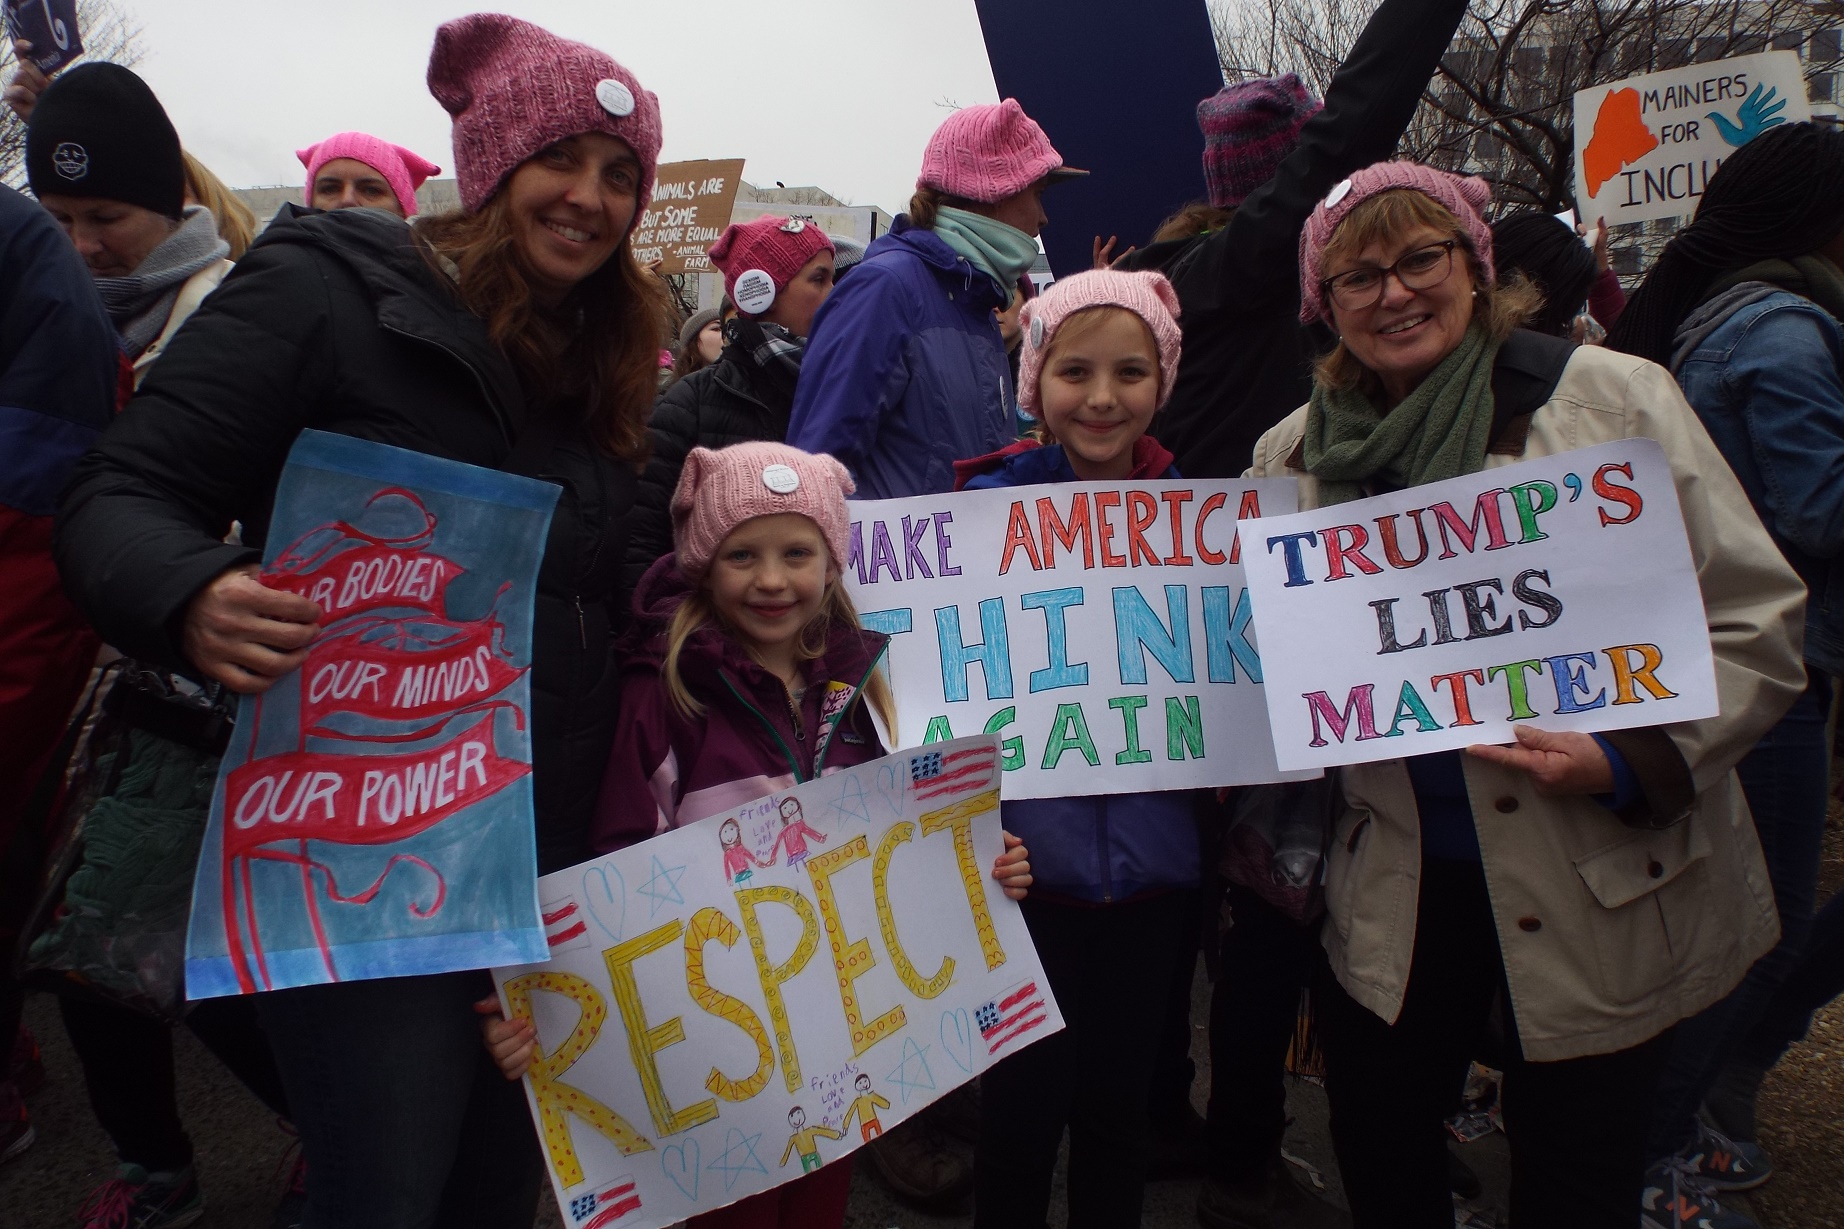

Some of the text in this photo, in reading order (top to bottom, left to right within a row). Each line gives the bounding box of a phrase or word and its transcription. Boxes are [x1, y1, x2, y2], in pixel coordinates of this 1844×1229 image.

[1641, 73, 1748, 115] MAINERS
[1660, 120, 1701, 145] FOR
[640, 205, 698, 229] BUT SOME
[651, 177, 725, 202] ANIMALS ARE
[637, 229, 655, 244] ARE
[656, 226, 684, 243] MORE
[686, 226, 721, 242] EQUAL
[684, 257, 711, 269] FARM
[1266, 461, 1643, 588] TRUMP'S
[337, 554, 445, 609] BODIES
[1367, 568, 1563, 655] LIES
[308, 645, 491, 709] OUR MINDS
[1301, 642, 1680, 748] MATTER
[233, 741, 488, 830] OUR POWER
[502, 788, 1007, 1190] RESPECT
